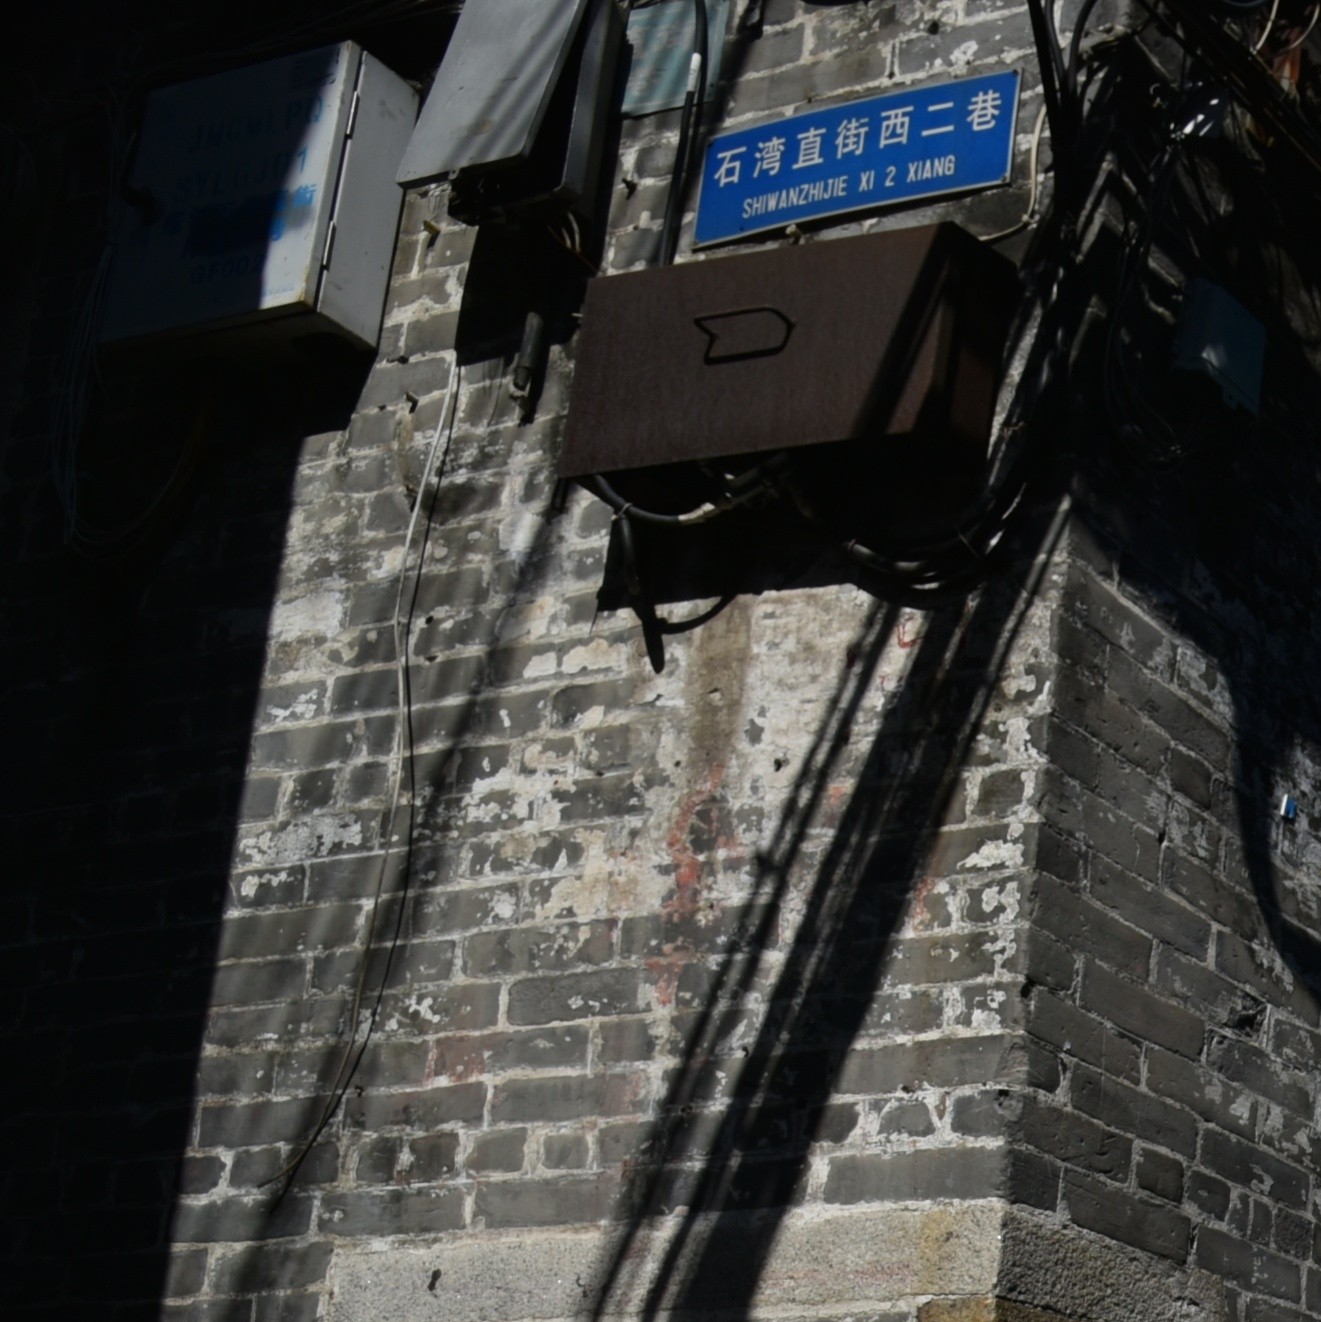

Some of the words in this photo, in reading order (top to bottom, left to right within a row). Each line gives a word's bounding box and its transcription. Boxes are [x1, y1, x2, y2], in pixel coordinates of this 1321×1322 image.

[713, 89, 1002, 188] 石湾直街西二巷
[741, 175, 848, 219] SHIWANZHIJIE
[858, 170, 874, 192] XI
[885, 165, 895, 187] 2
[907, 154, 956, 182] XIANG
